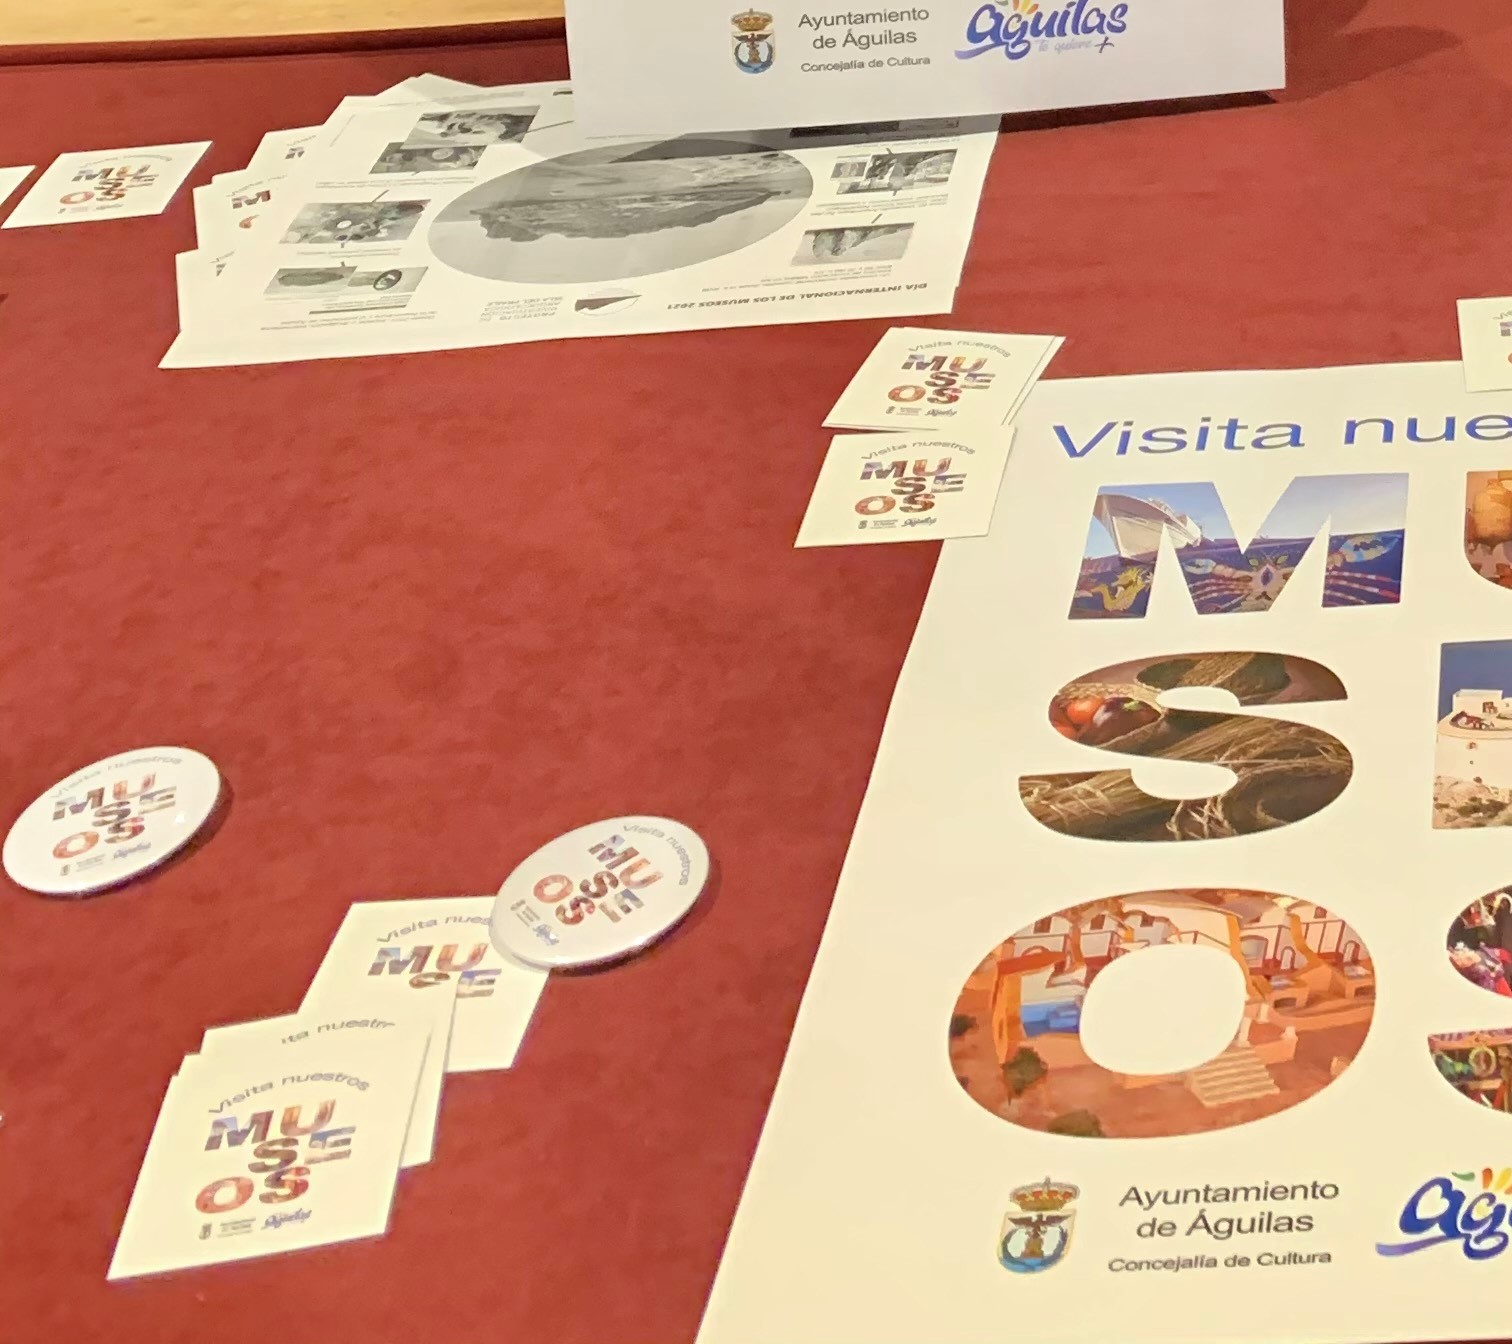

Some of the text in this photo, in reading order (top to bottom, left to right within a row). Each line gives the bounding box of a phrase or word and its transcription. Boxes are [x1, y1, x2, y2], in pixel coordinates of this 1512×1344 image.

[798, 8, 929, 31] Ayuntamiento
[813, 29, 917, 50] de Águilas
[868, 58, 884, 68] de
[887, 56, 931, 67] Cultura
[800, 284, 902, 300] INTERNACIONAL
[905, 282, 928, 290] DÍA
[667, 302, 695, 310] 2021
[699, 297, 750, 308] MUSEOS
[1052, 416, 1305, 459] Visita
[281, 1071, 370, 1091] nuestros
[1119, 1179, 1340, 1211] Ayuntamiento
[1136, 1209, 1315, 1240] de Águilas
[1108, 1249, 1332, 1274] Concejalía de Cultura
